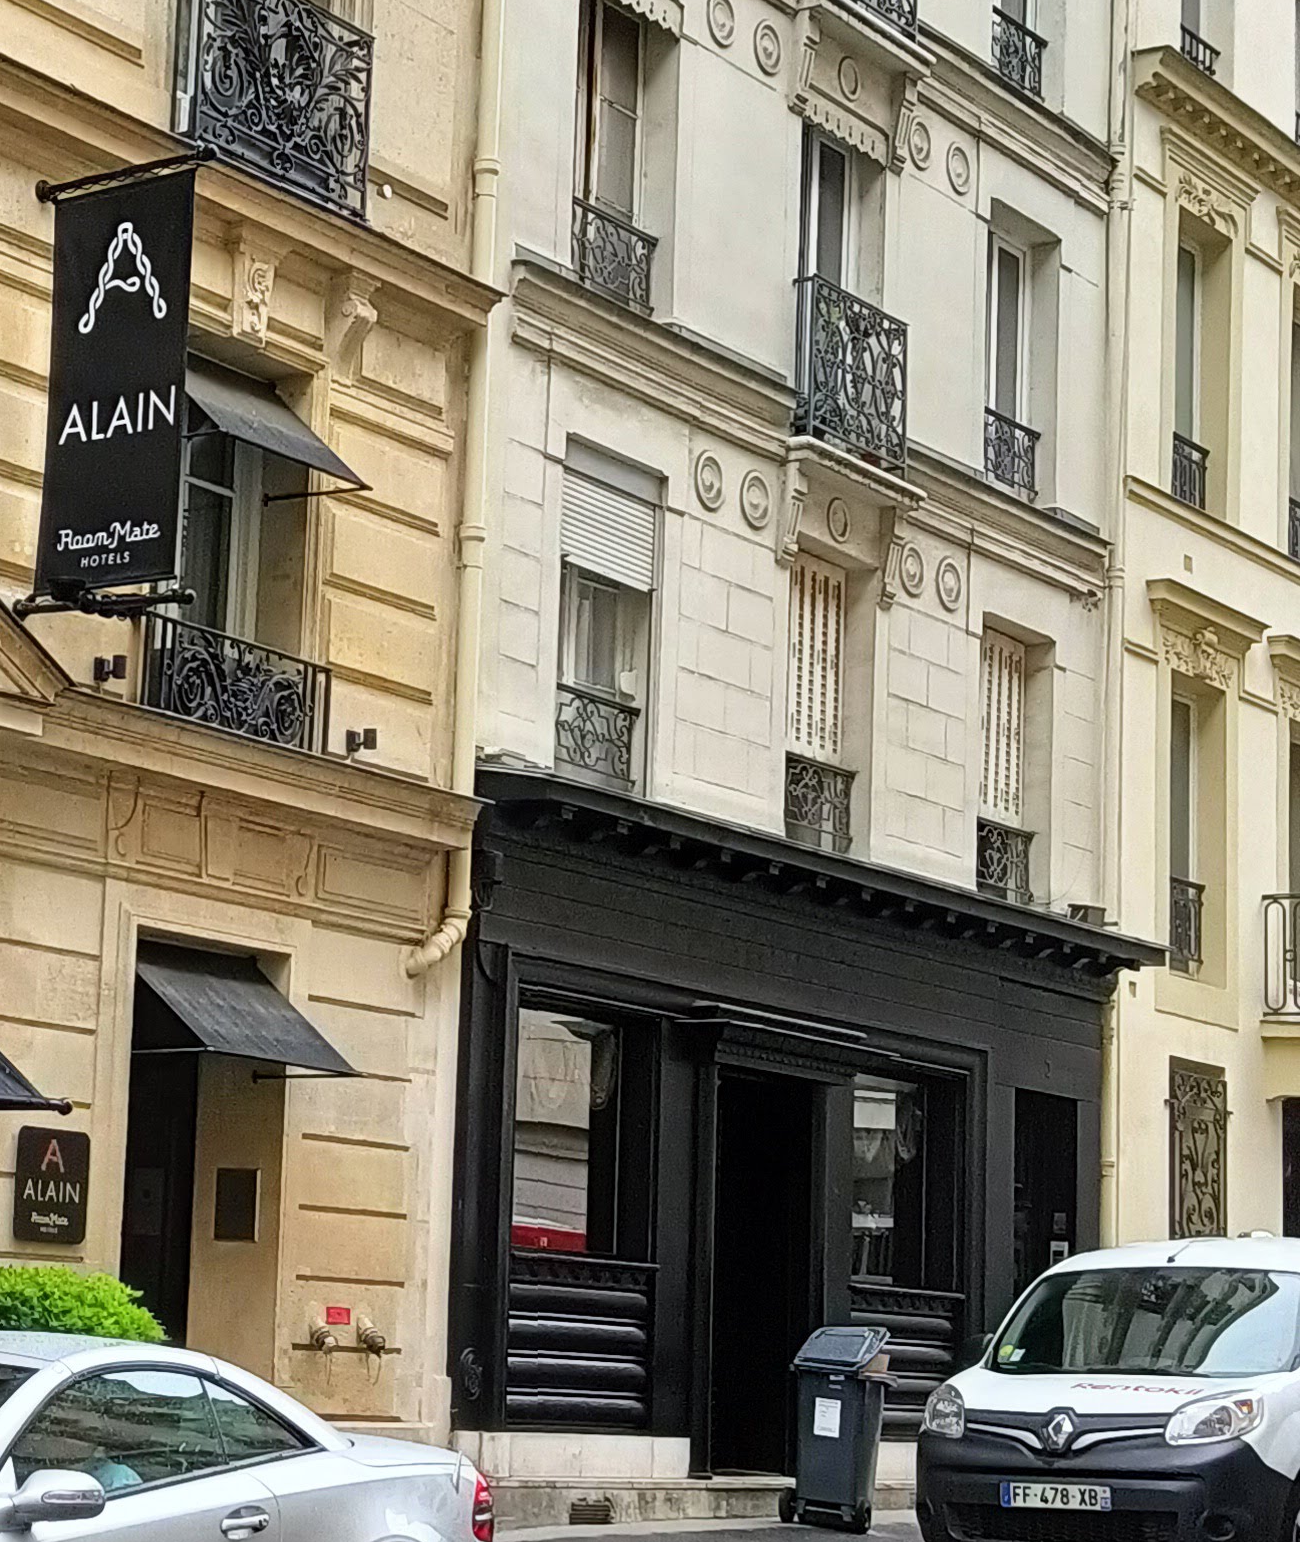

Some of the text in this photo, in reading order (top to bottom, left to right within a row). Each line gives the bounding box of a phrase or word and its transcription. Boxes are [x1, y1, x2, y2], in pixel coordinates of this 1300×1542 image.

[58, 385, 176, 445] ALAIN
[80, 551, 130, 568] HOTELS
[41, 1139, 65, 1173] A
[23, 1178, 80, 1203] ALAIN
[1012, 1485, 1098, 1507] FF-478-XB
